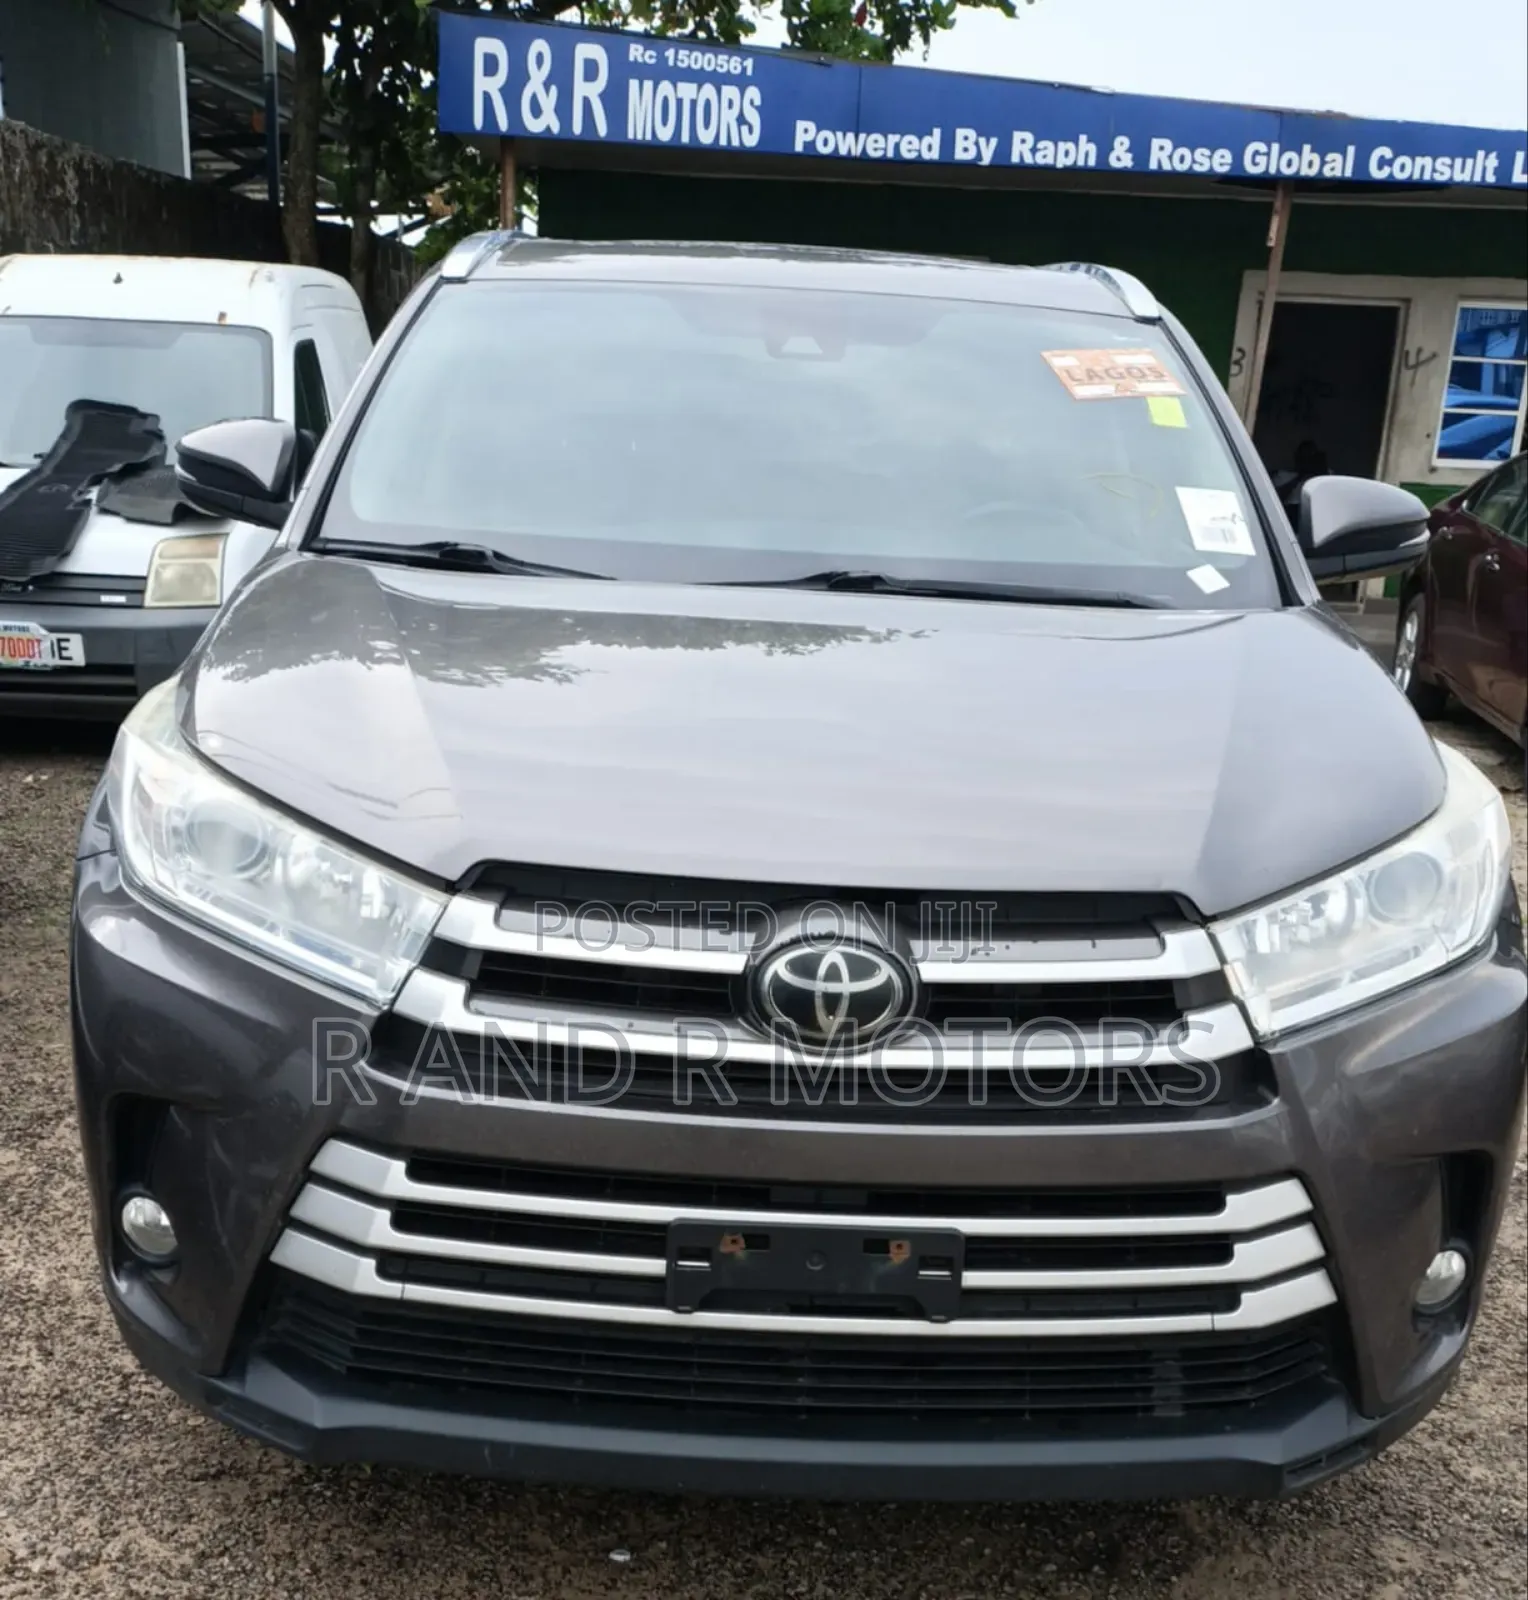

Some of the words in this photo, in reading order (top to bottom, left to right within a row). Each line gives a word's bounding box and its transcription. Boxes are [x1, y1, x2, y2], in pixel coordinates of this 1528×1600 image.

[629, 44, 656, 63] Rc
[665, 48, 754, 76] 1500561
[628, 79, 760, 146] MOTORS
[795, 120, 940, 159] Powered
[955, 129, 997, 164] By
[1012, 132, 1096, 167] Raph
[1109, 136, 1132, 167] &
[1150, 139, 1232, 172] Rose
[1244, 142, 1354, 176] Global
[1370, 147, 1498, 182] Consult
[1064, 366, 1166, 382] LAGOS
[1229, 346, 1246, 378] 3
